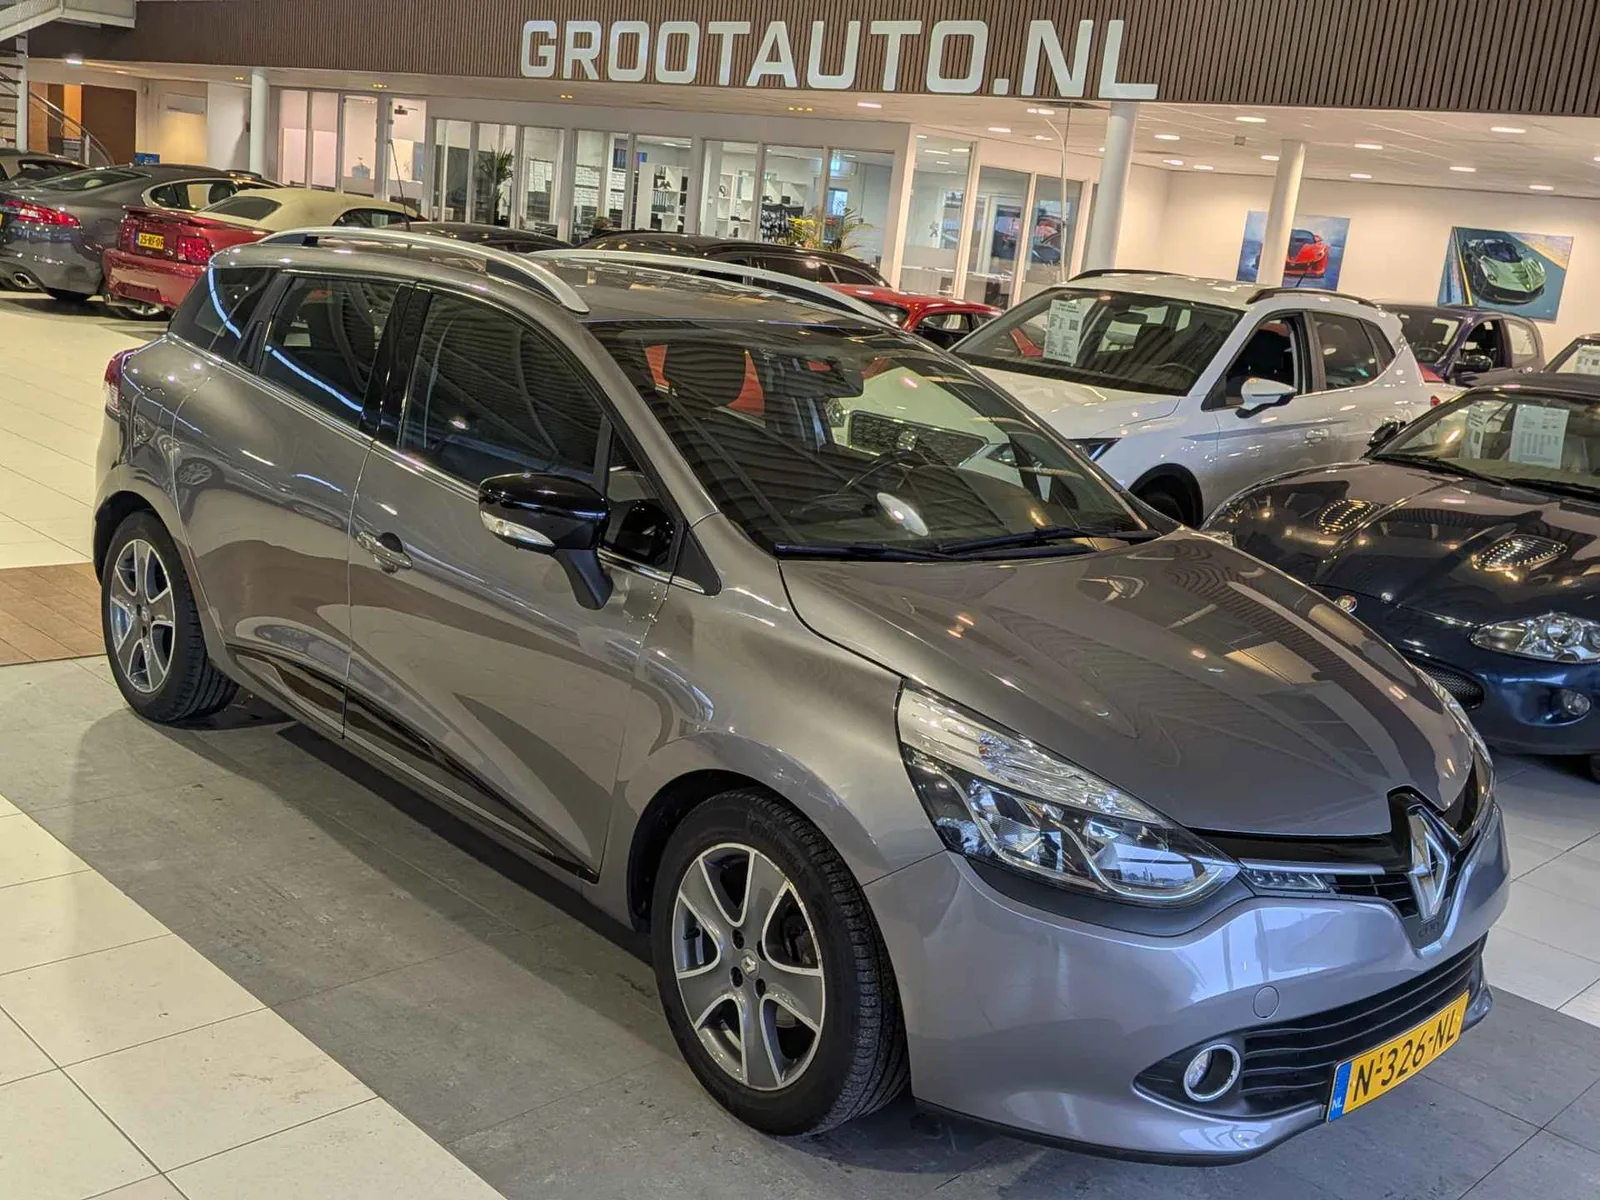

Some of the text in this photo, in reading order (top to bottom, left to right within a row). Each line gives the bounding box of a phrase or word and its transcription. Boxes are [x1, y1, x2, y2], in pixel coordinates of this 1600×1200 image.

[520, 19, 1159, 100] GROOTAUTO.NL
[1352, 1008, 1457, 1103] N-326-NL
[1331, 1096, 1343, 1111] NL
